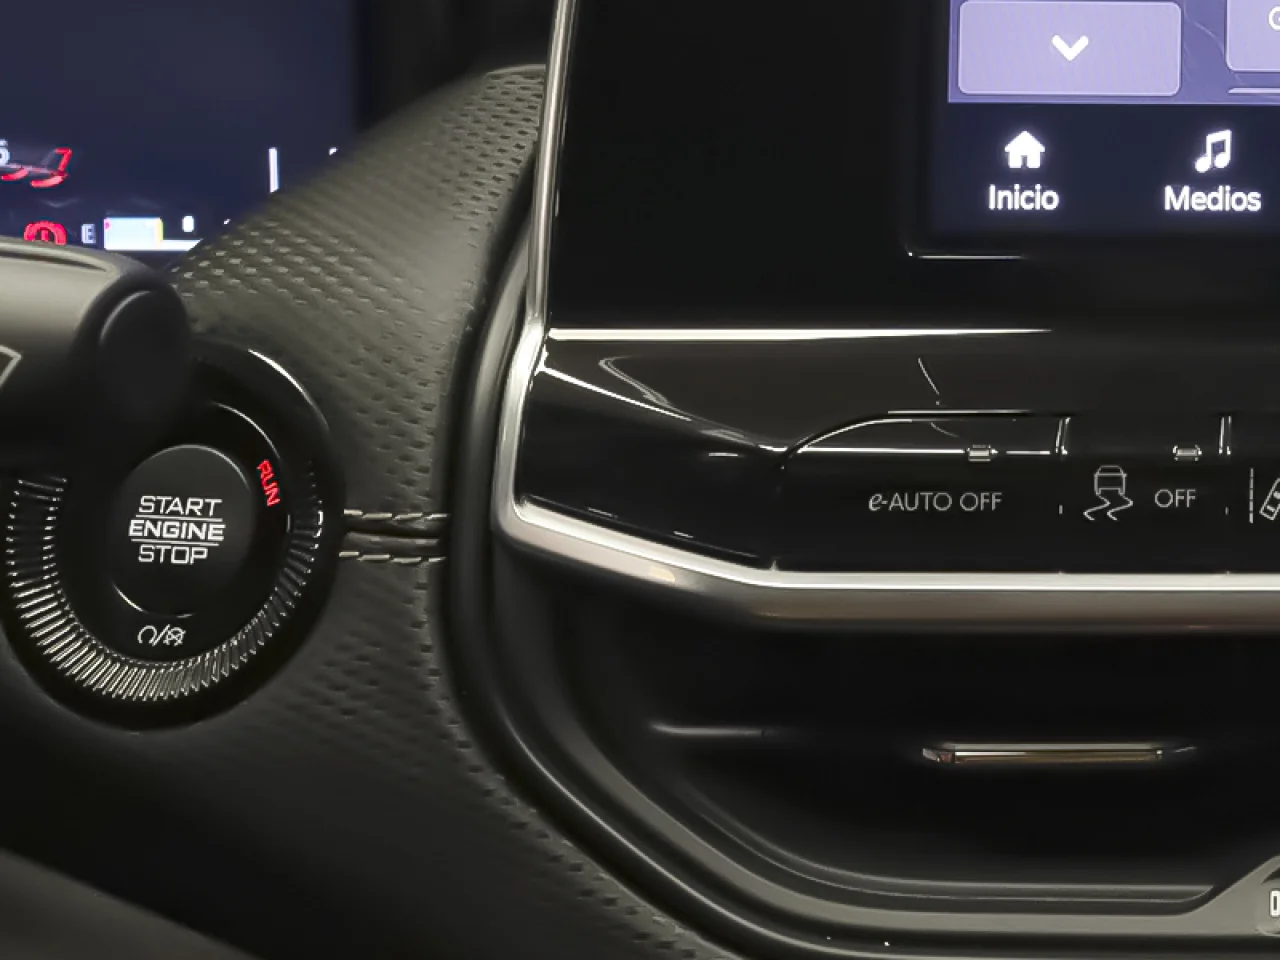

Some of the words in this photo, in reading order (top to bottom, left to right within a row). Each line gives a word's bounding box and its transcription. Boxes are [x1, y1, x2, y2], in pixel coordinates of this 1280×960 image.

[988, 184, 1060, 211] Inicio
[1163, 184, 1262, 213] Medios
[256, 459, 281, 507] RUN
[138, 495, 223, 517] START
[868, 491, 953, 512] e-AUTO
[959, 491, 1003, 512] OFF
[1154, 488, 1197, 508] OFF
[128, 519, 227, 542] ENGINE
[137, 545, 209, 565] STOP
